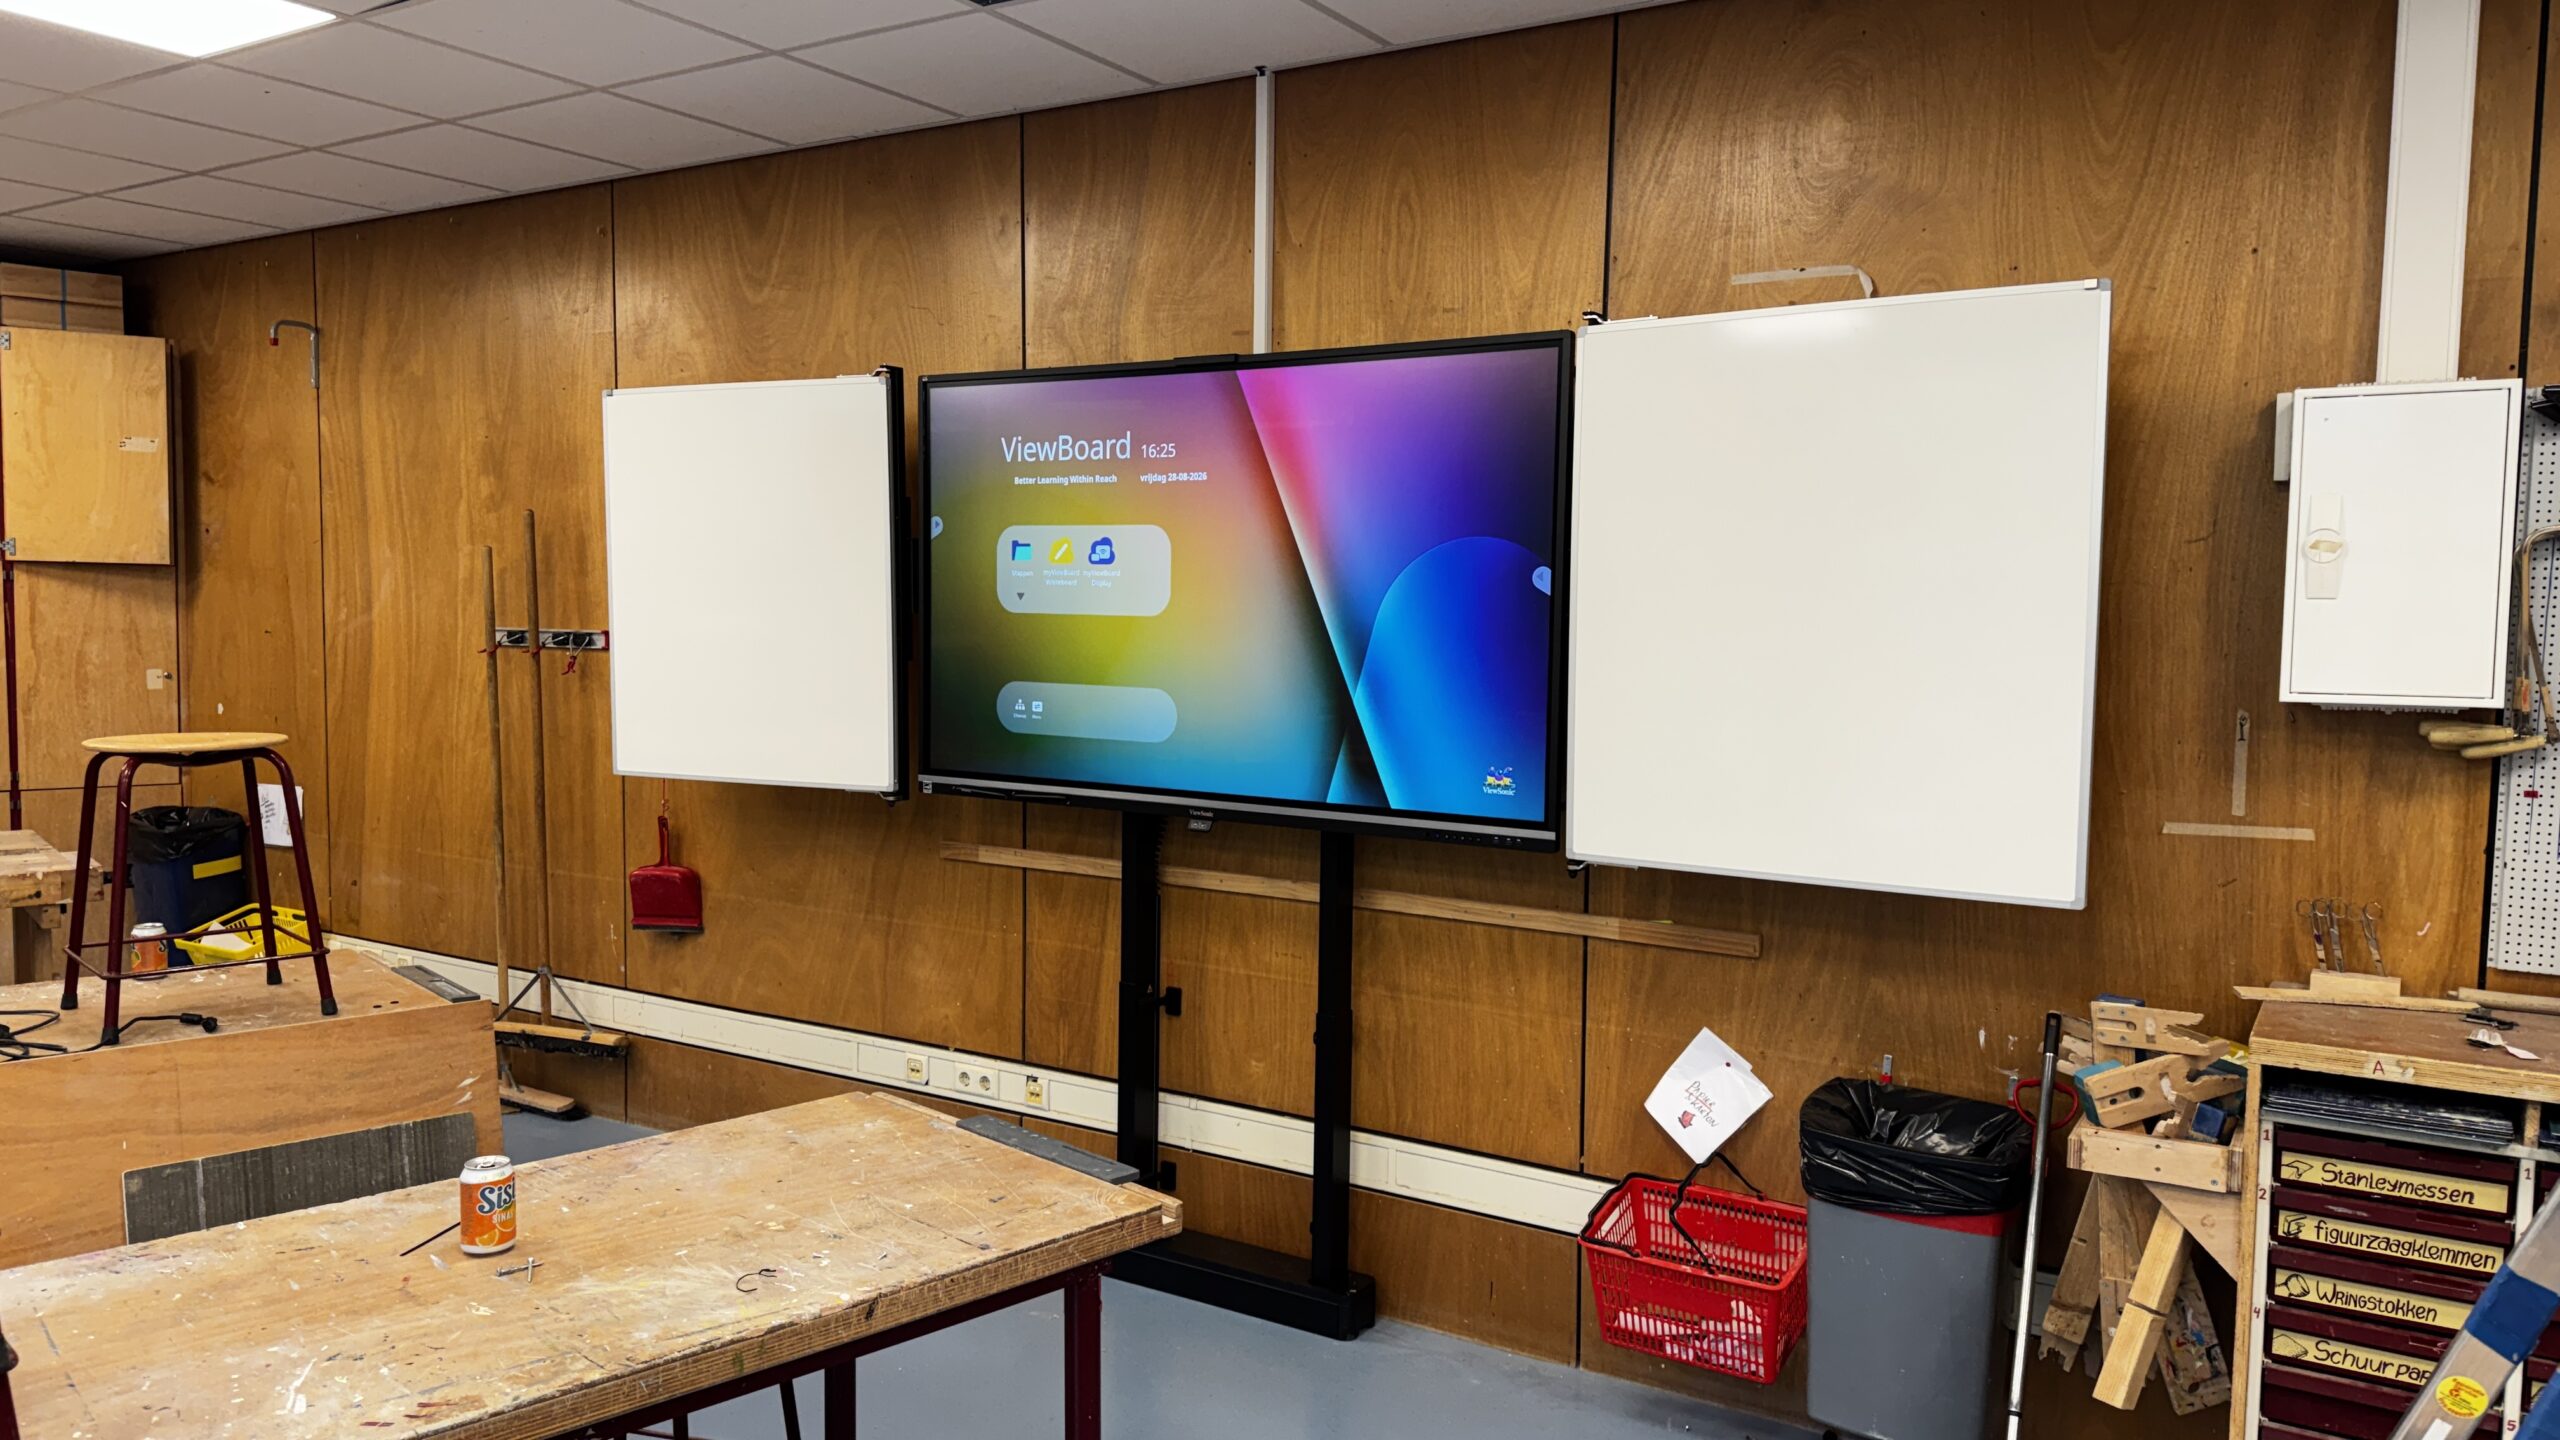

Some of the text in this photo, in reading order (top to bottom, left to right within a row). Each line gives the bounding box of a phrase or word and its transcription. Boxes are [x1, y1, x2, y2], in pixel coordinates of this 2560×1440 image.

[1001, 430, 1131, 463] ViewBoard
[1141, 443, 1176, 459] 16:25
[1014, 474, 1118, 486] Better Learning Within Reach
[1140, 472, 1207, 484] vrijdag 28-08-2026
[2372, 1060, 2385, 1075] A
[2262, 1129, 2271, 1141] 1
[2524, 1167, 2532, 1180] 1
[2321, 1162, 2475, 1205] Stanleymessen
[2258, 1188, 2267, 1200] 2
[2314, 1219, 2497, 1270] figuurzaagklemmen
[2253, 1306, 2261, 1319] 4
[2506, 1419, 2517, 1431] 5
